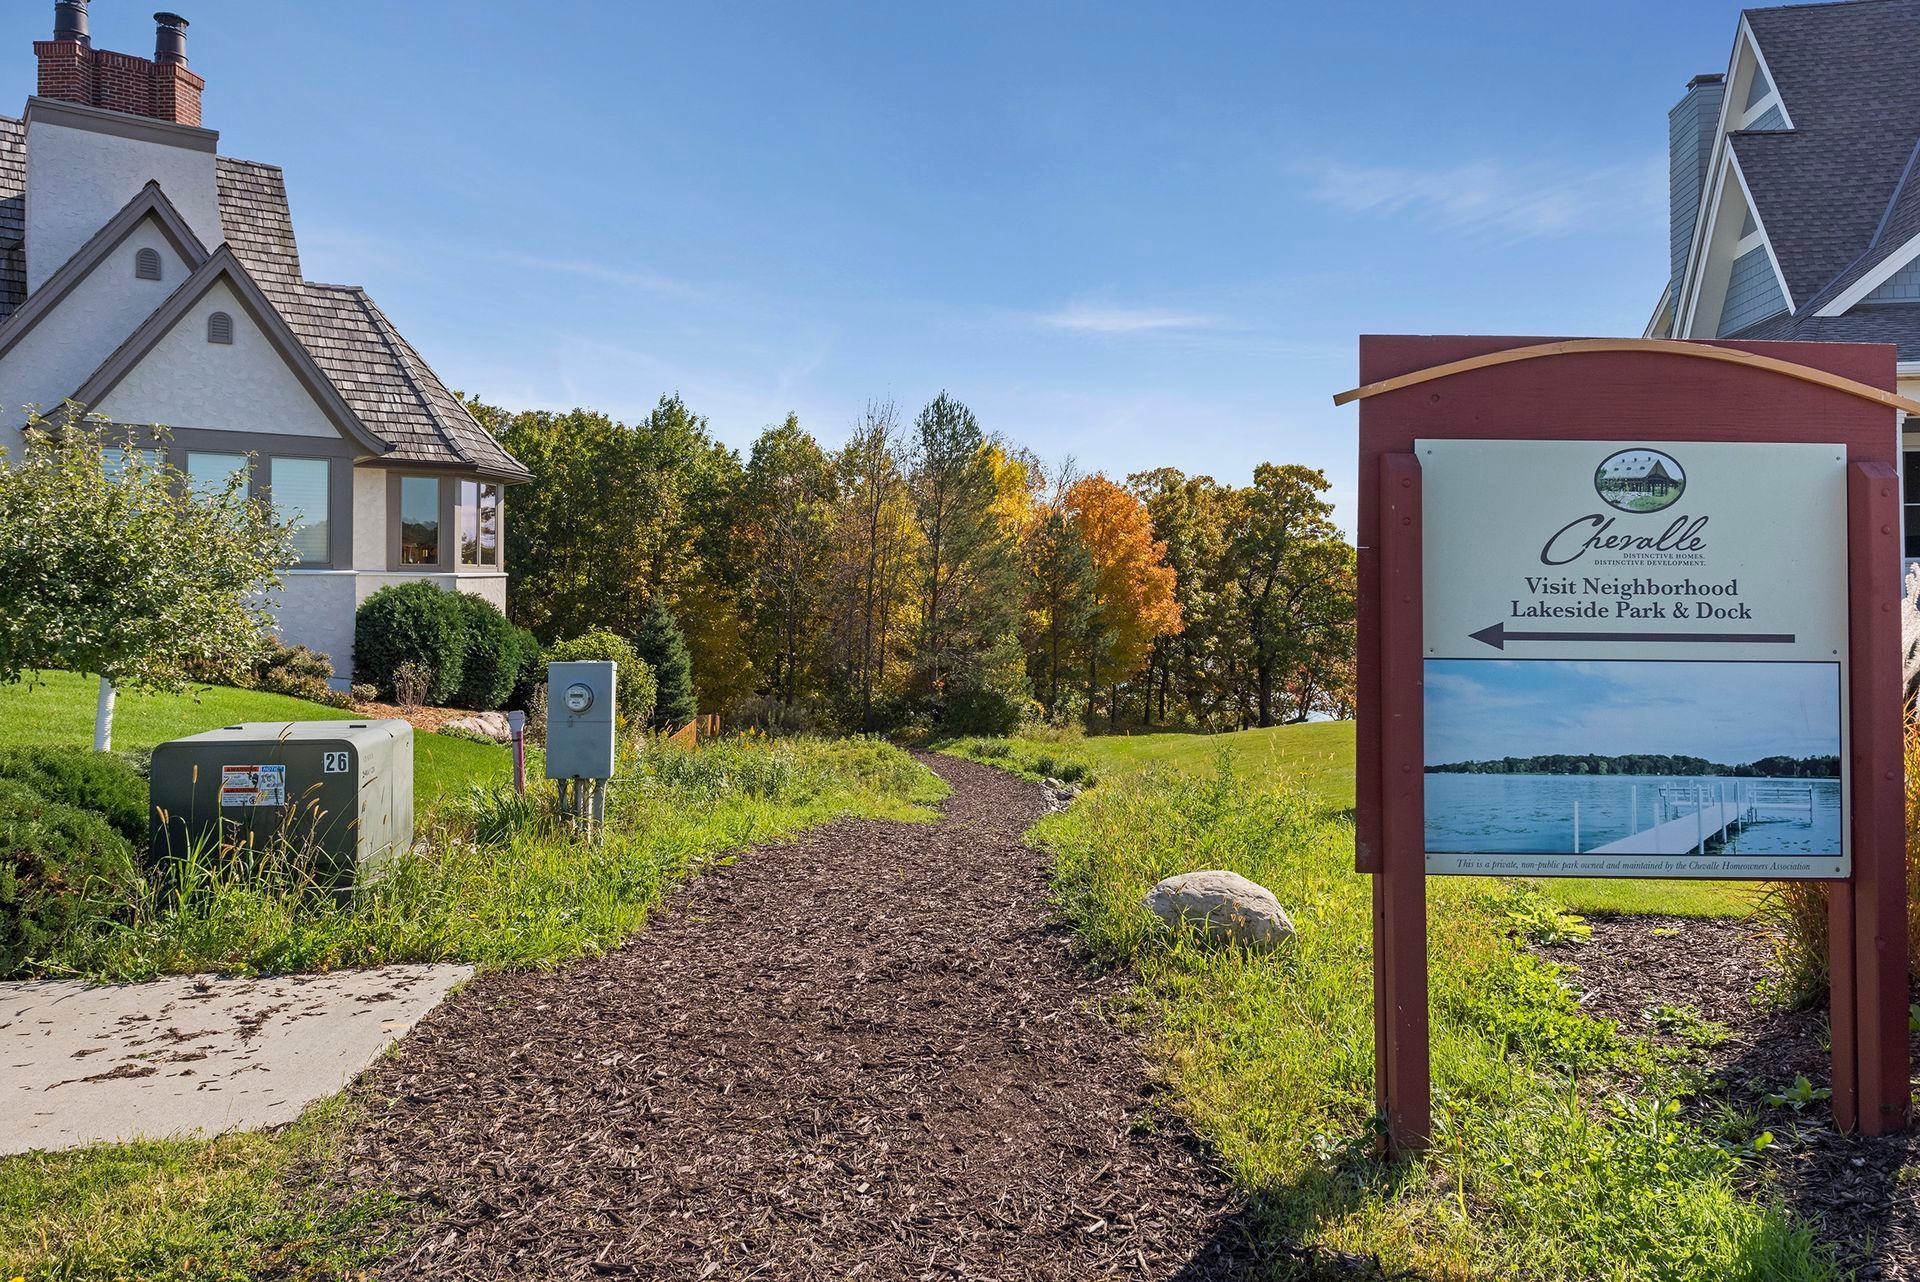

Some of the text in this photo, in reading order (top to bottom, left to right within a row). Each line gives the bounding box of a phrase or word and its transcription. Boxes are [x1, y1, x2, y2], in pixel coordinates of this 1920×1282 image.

[1540, 513, 1709, 566] Chevalle
[1524, 577, 1739, 600] Visit Neighborhood
[1510, 600, 1753, 619] Lakeside Park & Dock
[326, 753, 347, 772] 26
[1457, 859, 1474, 868] This
[1477, 860, 1483, 868] is
[1491, 860, 1518, 870] private,
[1521, 860, 1560, 871] non-public
[1561, 860, 1579, 871] park
[1580, 860, 1604, 869] owned
[1606, 861, 1620, 869] and
[1623, 861, 1663, 870] maintained
[1665, 861, 1673, 872] by
[1676, 861, 1686, 869] the
[1689, 861, 1719, 870] Chevalle
[1722, 861, 1768, 870] Homeowners
[1770, 861, 1811, 871] Association
